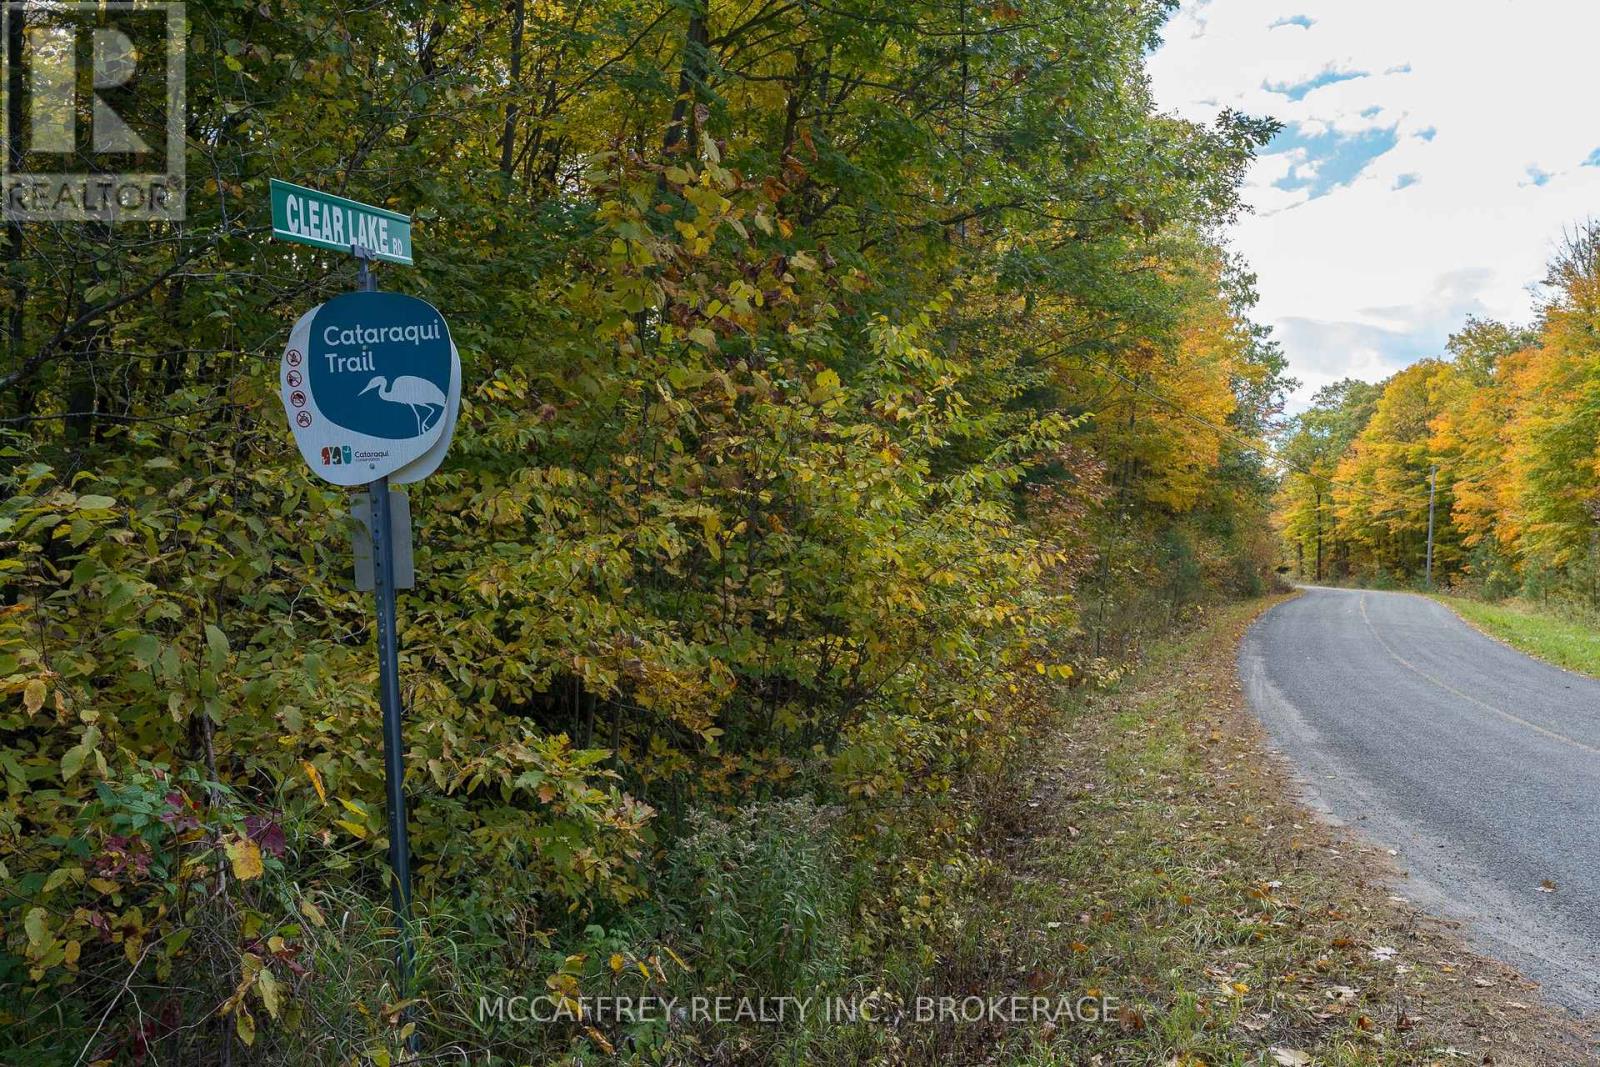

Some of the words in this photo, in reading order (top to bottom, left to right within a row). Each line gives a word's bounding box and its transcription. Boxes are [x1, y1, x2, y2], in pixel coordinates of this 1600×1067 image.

[286, 193, 345, 245] CLEAR
[347, 210, 389, 253] LAKE
[392, 237, 403, 256] RD
[323, 319, 441, 346] Cataraqui
[324, 345, 376, 373] Trail
[354, 449, 390, 459] Cataraqui
